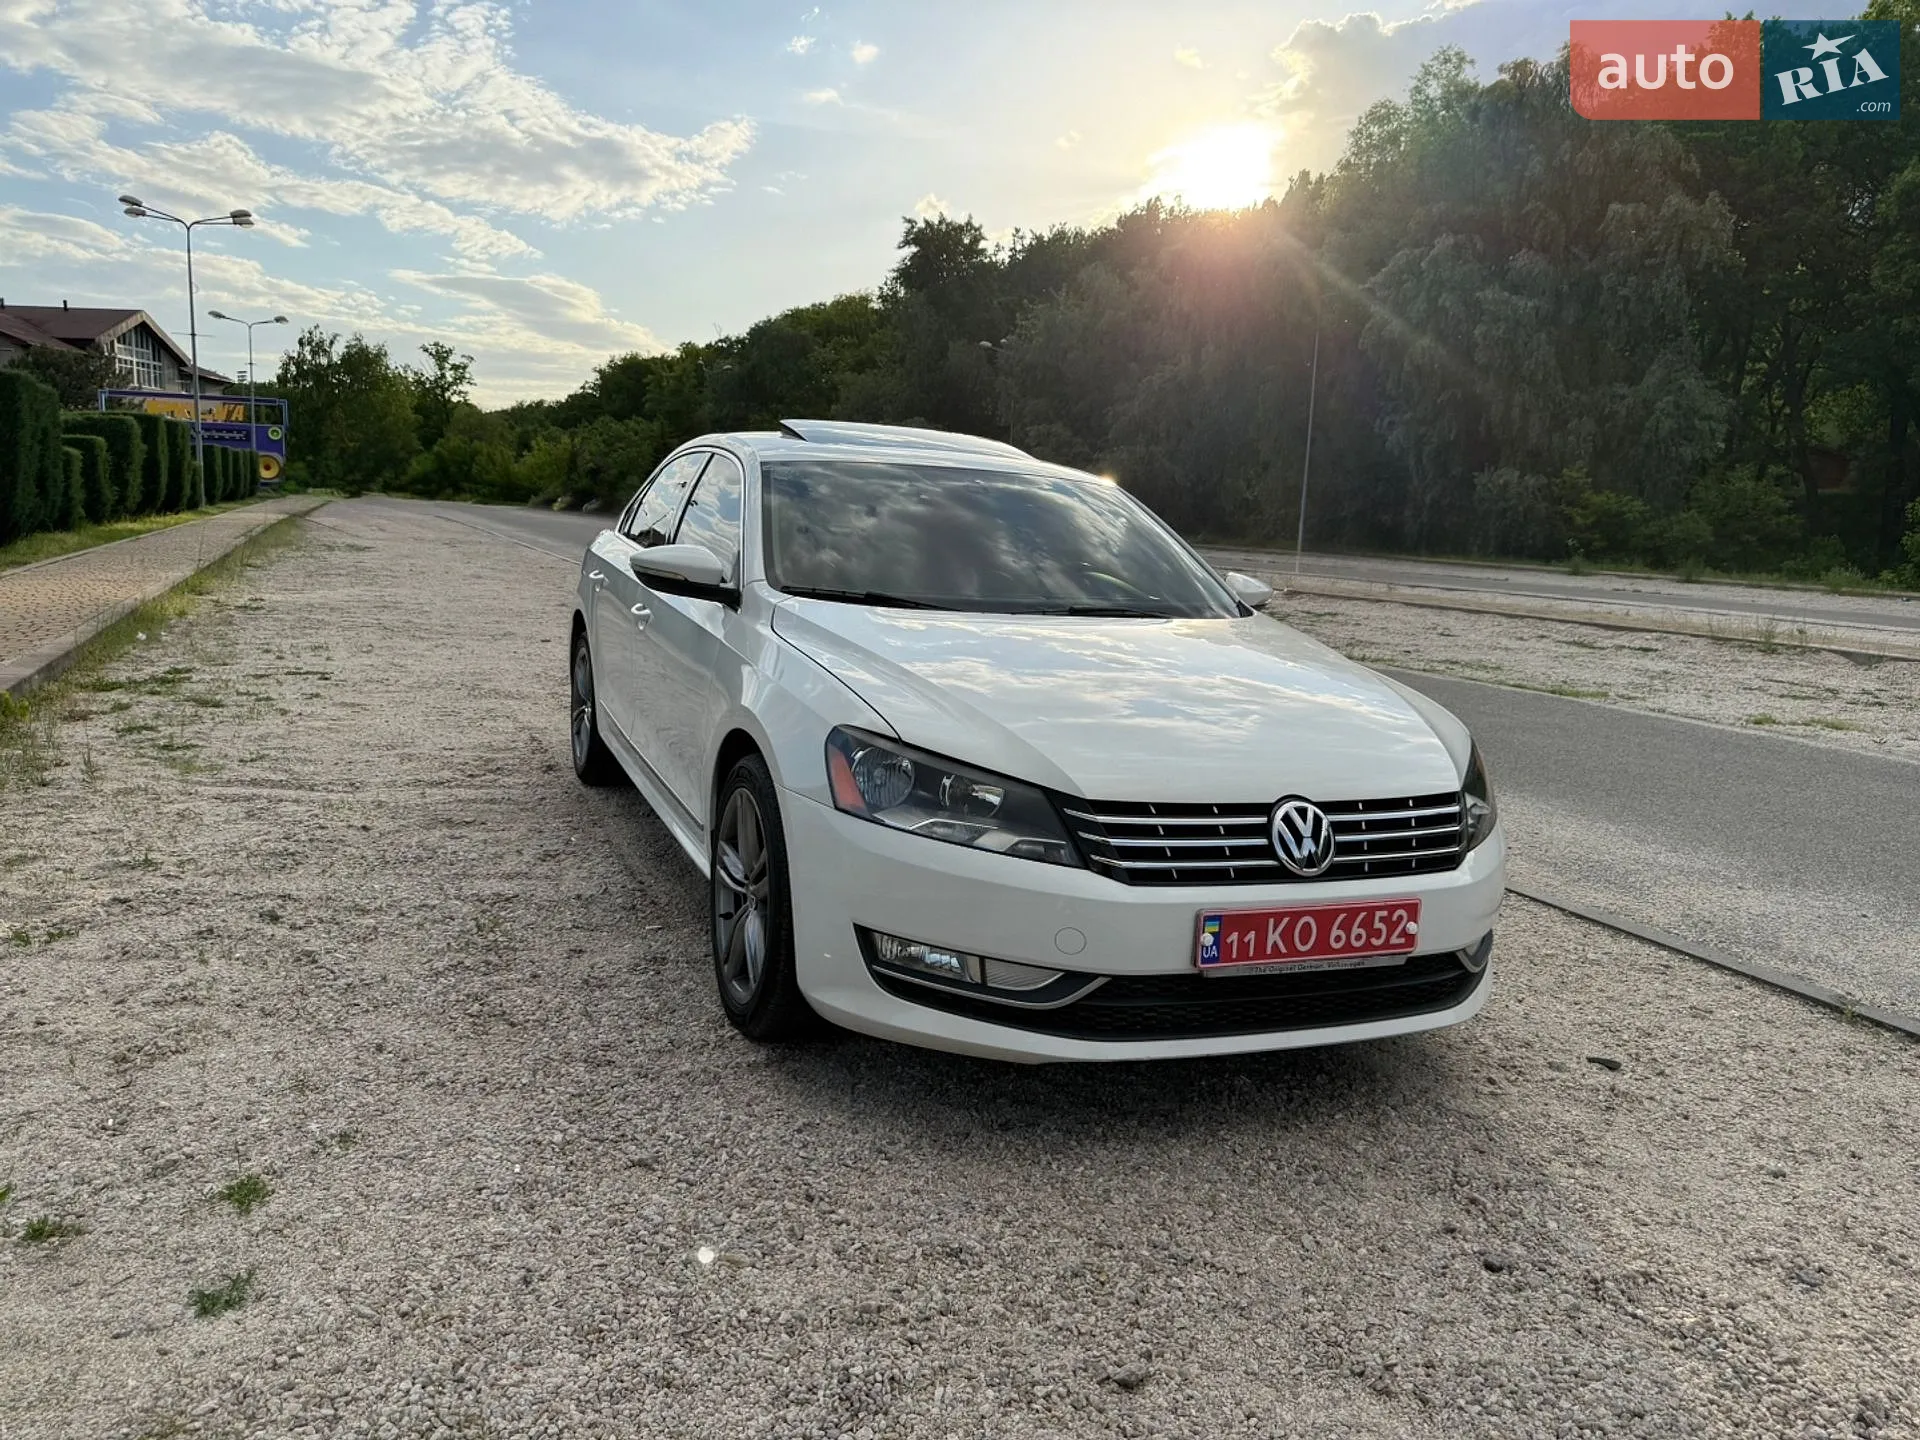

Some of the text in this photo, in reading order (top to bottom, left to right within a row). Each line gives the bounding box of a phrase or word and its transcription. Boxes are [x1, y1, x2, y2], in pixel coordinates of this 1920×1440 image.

[1226, 909, 1408, 959] 11 KO 6652
[1202, 946, 1218, 958] UA
